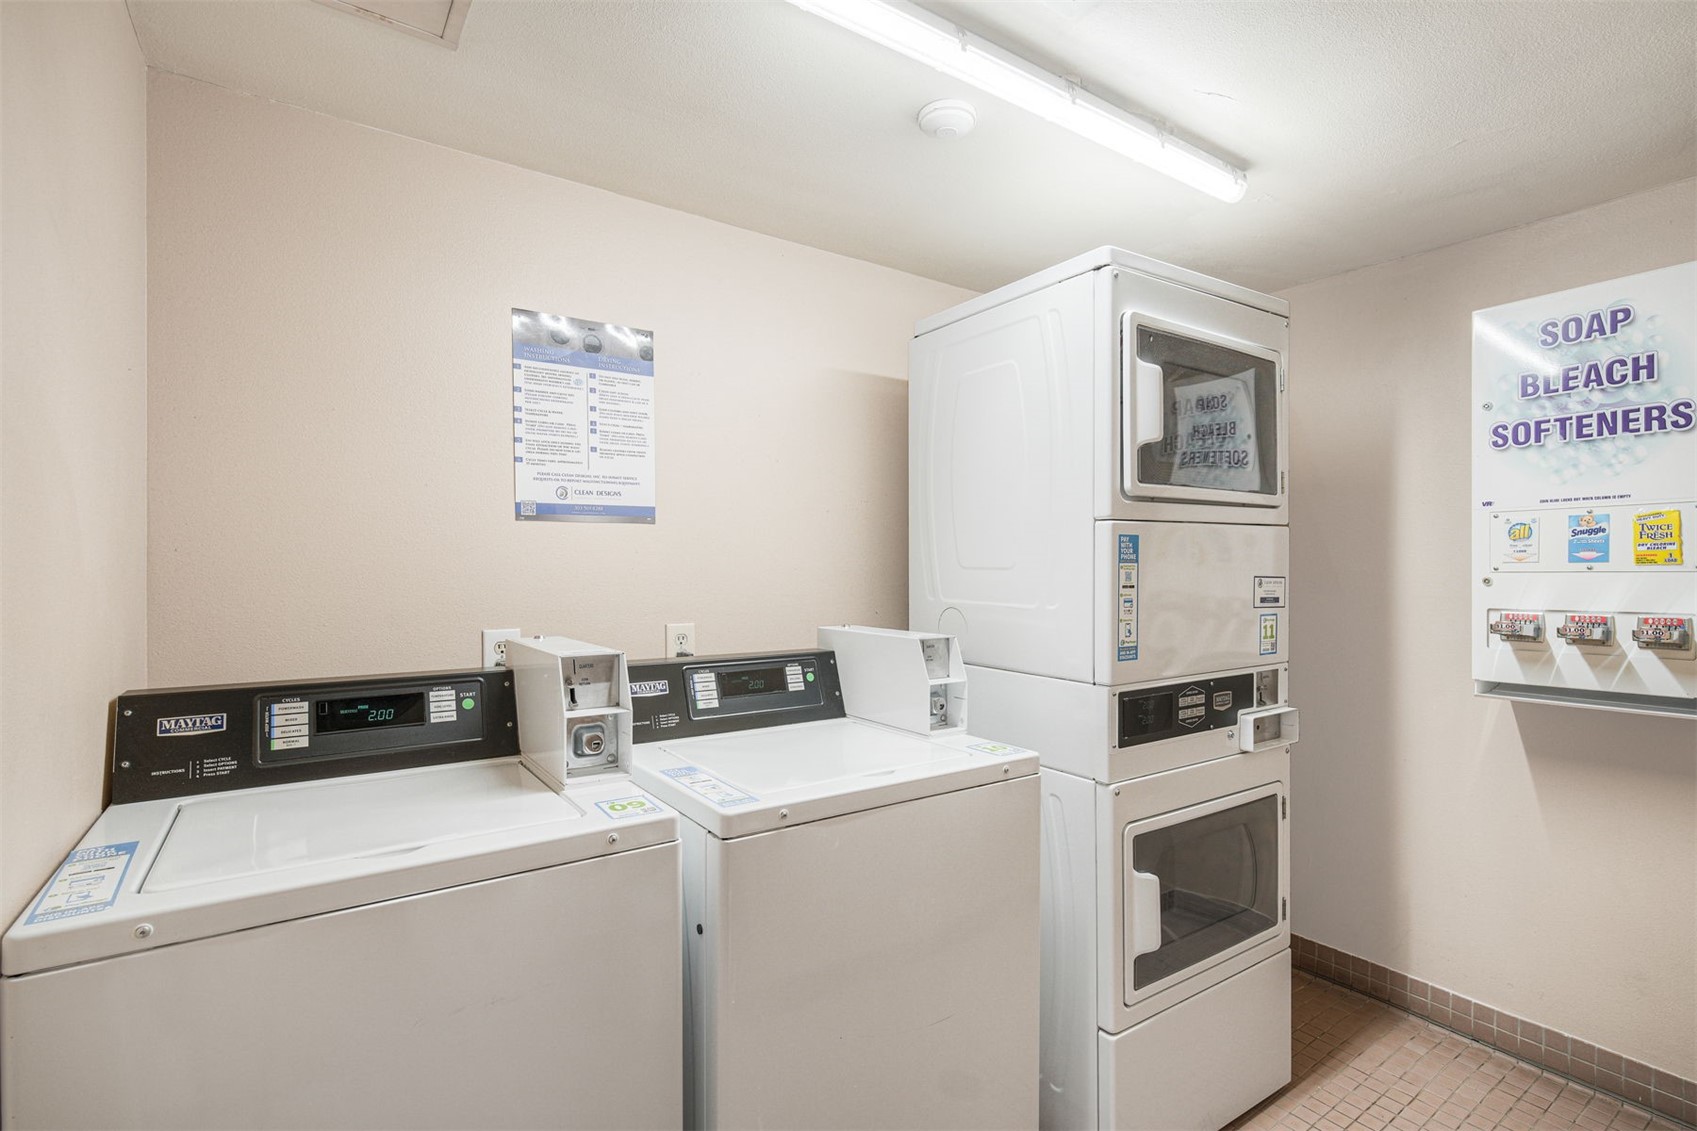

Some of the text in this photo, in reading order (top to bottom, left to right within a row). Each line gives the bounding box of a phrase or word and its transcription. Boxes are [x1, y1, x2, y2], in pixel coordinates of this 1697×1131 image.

[1539, 305, 1633, 348] SOAP
[523, 346, 554, 355] WASHING
[523, 352, 571, 364] INSTRUCTIONS
[598, 362, 642, 373] INSTRUCTIONS
[1519, 352, 1658, 399] BLEACH
[1490, 400, 1695, 449] SOFTENERS
[1509, 524, 1530, 542] all
[1571, 525, 1607, 538] Snuggle
[1638, 523, 1673, 531] TWICE
[1640, 531, 1673, 540] FRESH
[1262, 624, 1275, 640] 11
[632, 682, 666, 693] MAYTAG
[748, 680, 765, 690] 2.00
[368, 708, 394, 721] 2.00
[160, 716, 222, 730] MAYTAG
[151, 768, 186, 776] INSTRUCTIONS
[609, 800, 646, 812] 09
